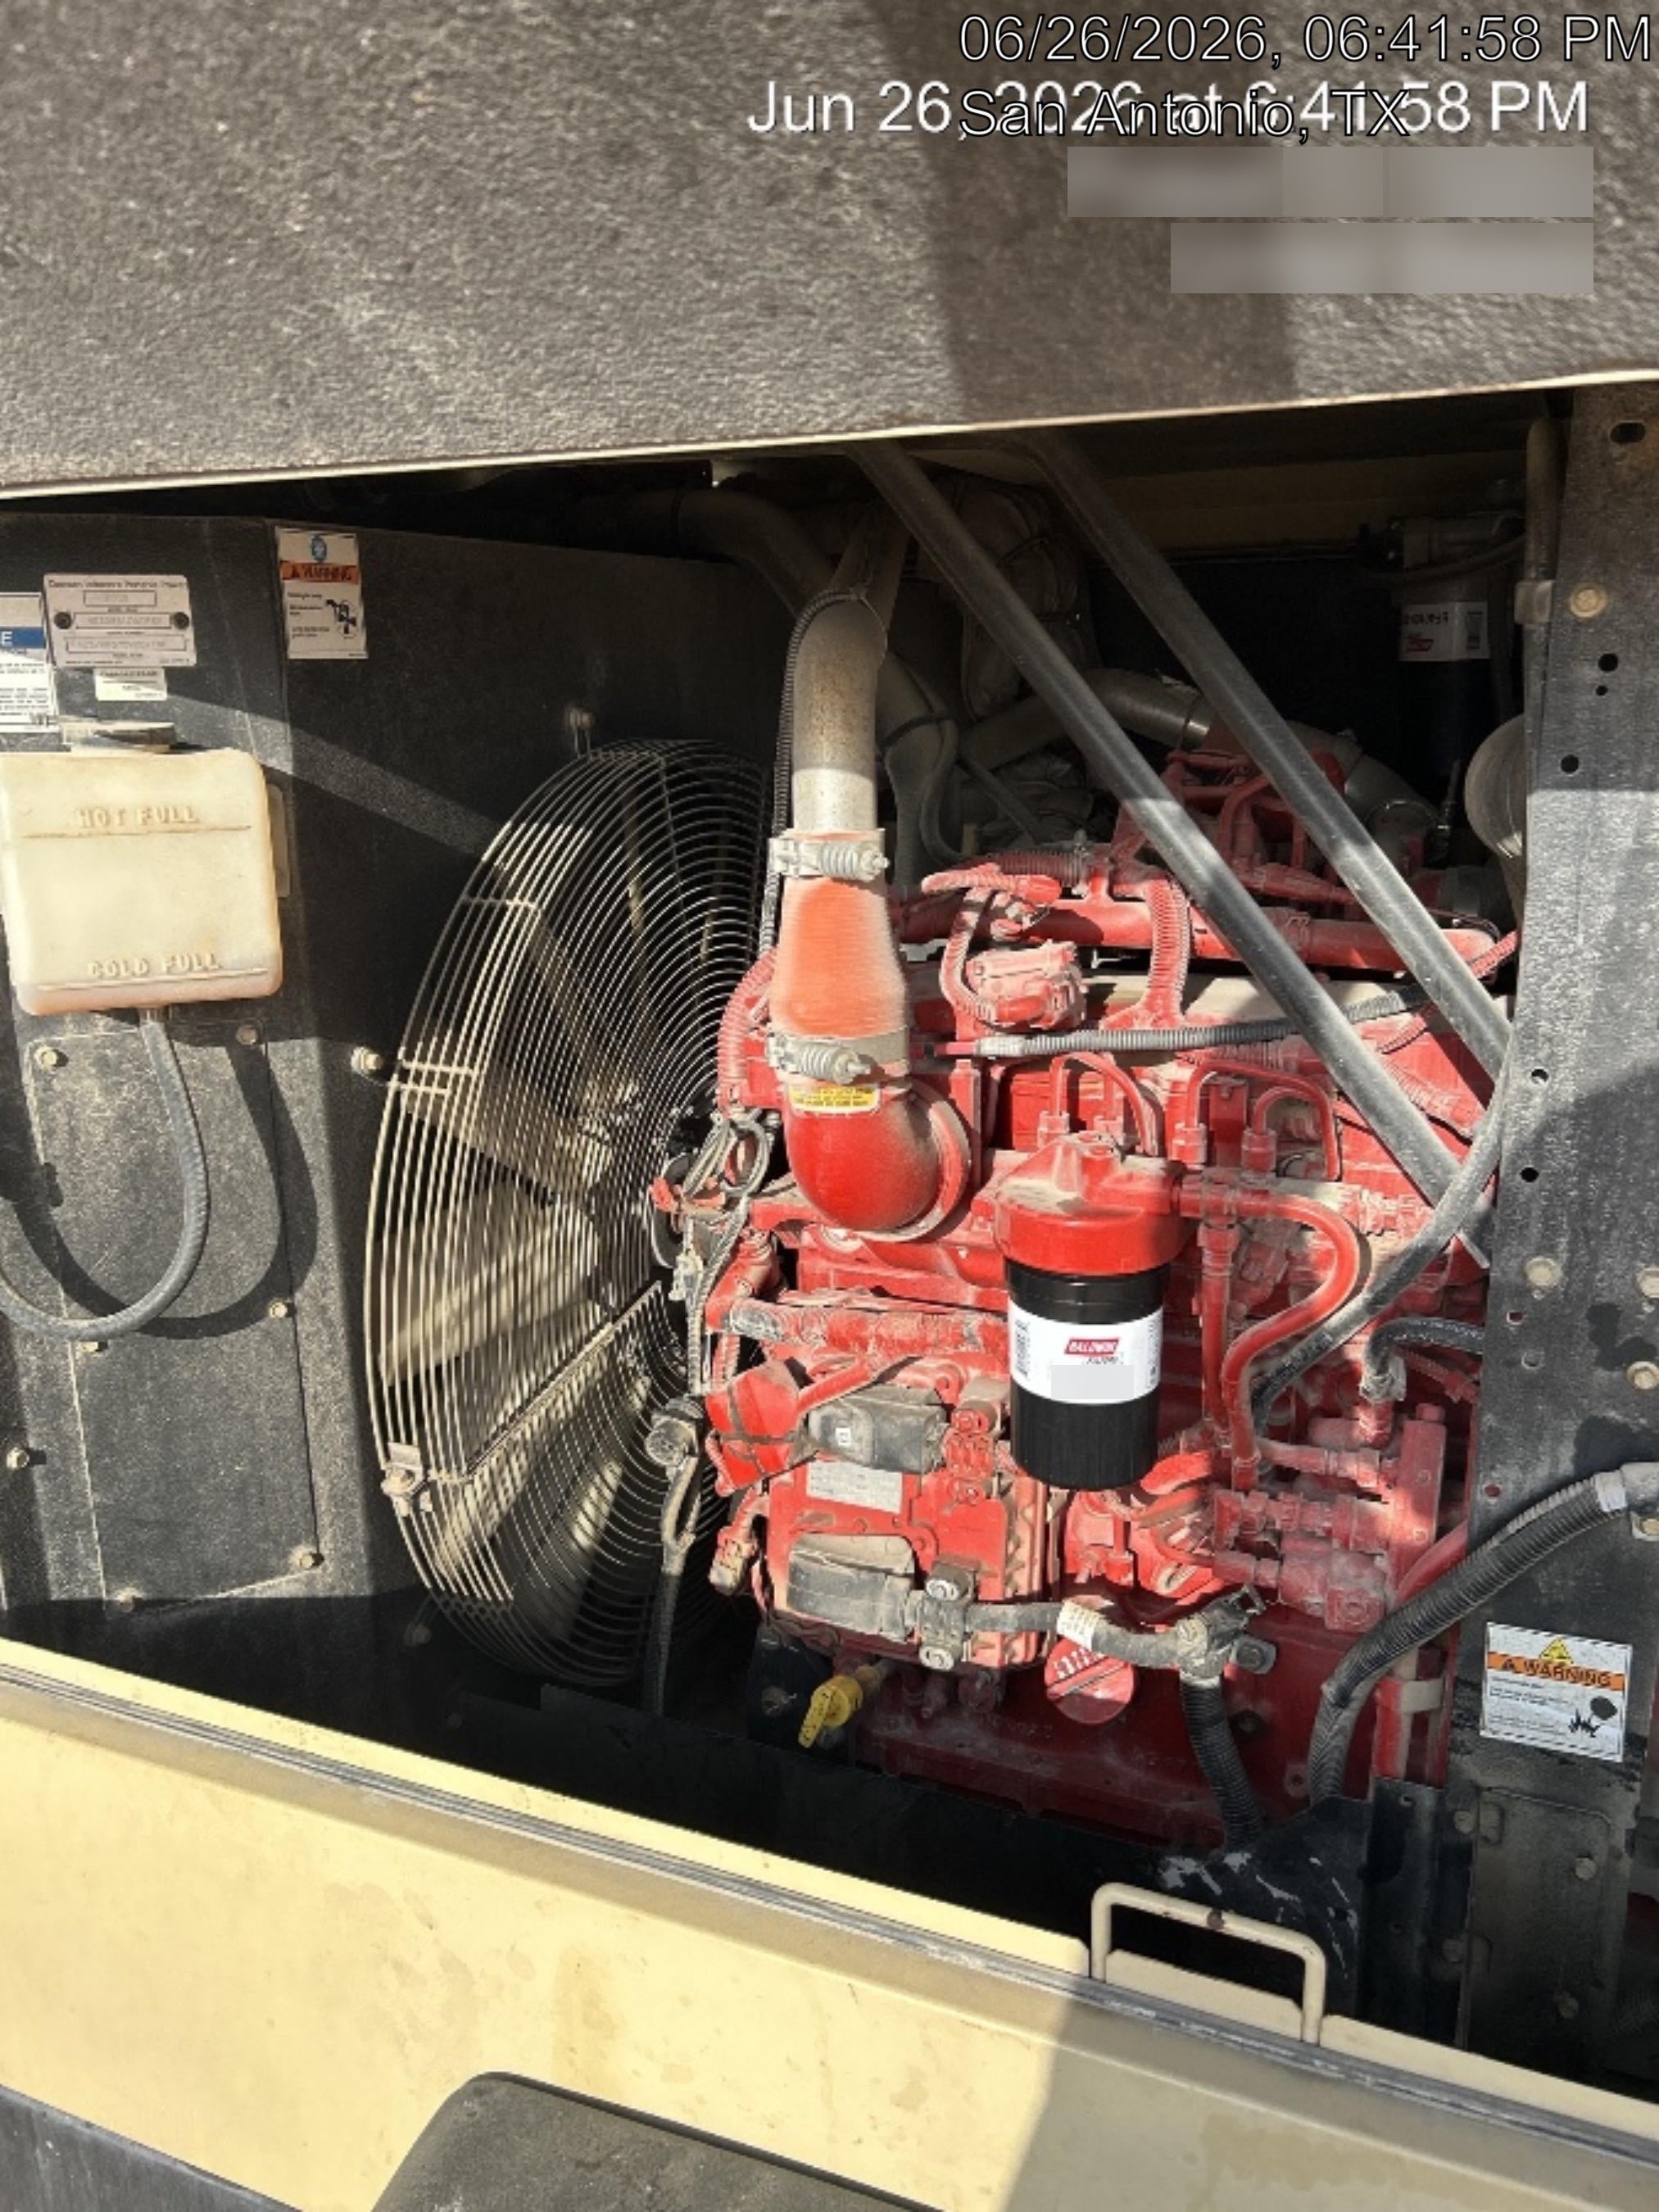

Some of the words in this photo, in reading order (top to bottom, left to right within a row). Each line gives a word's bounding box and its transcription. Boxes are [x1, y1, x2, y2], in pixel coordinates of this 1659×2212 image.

[77, 807, 126, 827] HOT
[137, 805, 199, 825] FULL
[162, 950, 224, 972] FULL
[1523, 1661, 1612, 1687] WARNING
